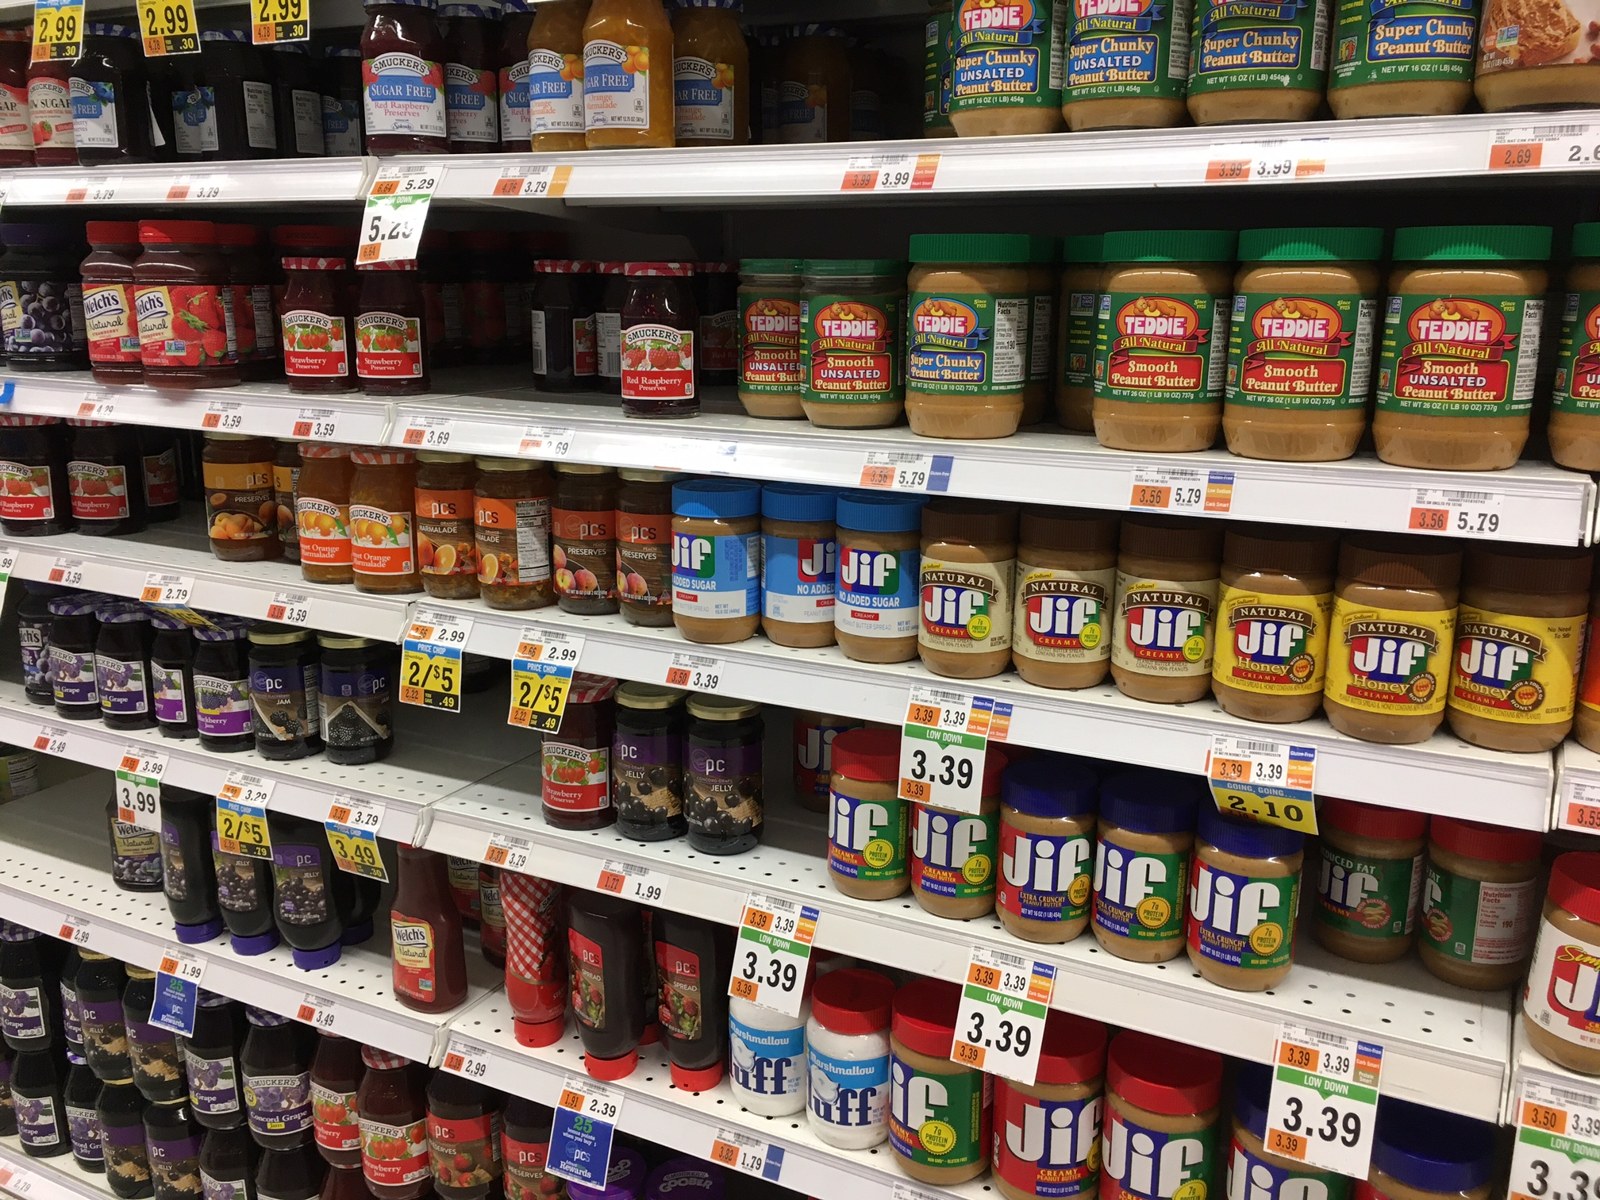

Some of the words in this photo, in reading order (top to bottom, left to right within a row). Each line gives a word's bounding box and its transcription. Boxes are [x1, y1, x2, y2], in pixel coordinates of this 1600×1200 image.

[146, 6, 189, 35] 2.99
[964, 6, 1020, 27] TEDDIE
[39, 16, 76, 42] 2.99
[289, 25, 303, 36] .30
[1375, 24, 1413, 40] Super
[1417, 19, 1474, 36] Chunky
[960, 34, 973, 46] All
[976, 32, 1018, 43] Natural
[62, 46, 76, 57] .30
[1376, 42, 1417, 57] Peanut
[1419, 42, 1471, 55] Butter
[373, 58, 428, 74] SMUCKER'S
[960, 68, 1024, 81] UNSALTED
[371, 84, 402, 97] SUGAR
[406, 85, 432, 98] FREE
[956, 83, 989, 95] Peanut
[991, 80, 1033, 92] Butter
[374, 101, 388, 110] Red
[390, 102, 430, 112] Raspberry
[384, 110, 420, 118] Preserves
[1505, 150, 1531, 164] 2.69
[1219, 164, 1242, 176] 3.99
[1257, 160, 1291, 176] 3.99
[404, 178, 434, 190] 5.29
[852, 174, 871, 186] 3.99
[882, 172, 909, 185] 3.99
[94, 190, 114, 199] 3.79
[524, 182, 547, 193] 3.79
[85, 292, 120, 312] Welch's
[88, 318, 124, 330] Natural
[822, 320, 878, 336] TEDDIE
[917, 316, 966, 332] TEDDIE
[1418, 321, 1490, 341] TEDDIE
[627, 329, 679, 343] SMUCKER'S
[916, 334, 926, 344] All
[929, 336, 967, 348] Natural
[820, 339, 833, 349] All
[836, 339, 875, 350] Natural
[1006, 341, 1016, 349] 190
[1413, 342, 1431, 354] All
[1436, 343, 1490, 358] Natural
[290, 356, 327, 365] Strawberry
[827, 358, 874, 367] Smooth
[911, 354, 932, 366] Super
[936, 354, 981, 370] Chunky
[1423, 361, 1478, 374] Smooth
[821, 369, 880, 378] UNSALTED
[911, 368, 939, 379] Peanut
[942, 369, 980, 380] Butter
[1410, 375, 1487, 386] UNSALTED
[627, 376, 639, 384] Red
[641, 376, 681, 386] Raspberry
[816, 380, 850, 390] Peanut
[852, 380, 887, 390] Butter
[1403, 386, 1448, 398] Peanut
[1451, 388, 1496, 399] Butter
[222, 416, 241, 427] 3.59
[314, 423, 334, 436] 3.59
[428, 431, 450, 444] 3.69
[899, 471, 925, 486] 5.79
[1174, 488, 1201, 504] 5.79
[1419, 512, 1444, 528] 3.56
[1457, 512, 1499, 531] 5.79
[842, 552, 896, 587] Jif
[925, 572, 985, 587] NATURAL
[166, 589, 187, 600] 2.79
[847, 594, 870, 606] ADDED
[872, 597, 900, 607] SUGAR
[924, 588, 984, 625] Jif
[288, 609, 306, 621] 3.59
[1241, 609, 1304, 621] NATURAL
[438, 630, 465, 642] 2.99
[931, 626, 964, 635] CREAMY
[1464, 625, 1530, 645] NATURAL
[1238, 623, 1303, 657] Jif
[418, 644, 433, 652] PRICE
[435, 646, 446, 654] CHOP
[548, 648, 576, 661] 2.99
[1238, 657, 1290, 674] Honey
[1461, 640, 1528, 681] Jif
[693, 674, 718, 689] 3.39
[1242, 671, 1276, 681] CREAMY
[1459, 676, 1511, 700] Honey
[404, 689, 419, 699] 2.22
[439, 697, 454, 707] .49
[1463, 693, 1495, 704] CREAMY
[514, 710, 527, 722] 2.22
[542, 718, 556, 728] .49
[914, 708, 933, 722] 3.39
[943, 710, 966, 725] 3.39
[926, 730, 941, 740] LOW
[942, 734, 962, 744] DOWN
[50, 740, 66, 752] 2.49
[142, 761, 162, 774] 3.99
[911, 750, 973, 789] 3.39
[1220, 762, 1242, 778] 3.39
[1256, 763, 1282, 780] 3.39
[711, 784, 733, 792] JELLY
[122, 788, 156, 814] 3.99
[1228, 796, 1303, 822] 2.10
[355, 812, 378, 824] 3.79
[913, 809, 987, 868] Jif
[253, 847, 267, 856] .79
[336, 840, 375, 865] 3.49
[509, 854, 526, 867] 3.79
[1003, 835, 1090, 891] Jif
[370, 869, 382, 877] .30
[636, 883, 661, 900] 1.99
[1191, 868, 1280, 935] Jif
[74, 930, 89, 942] 2.99
[394, 928, 424, 942] Welch's
[1200, 930, 1218, 941] EXTRA
[1221, 938, 1246, 948] CRUNCHY
[1265, 928, 1272, 937] 7g
[399, 948, 427, 958] Natural
[182, 964, 201, 978] 1.99
[743, 952, 797, 991] 3.39
[673, 981, 698, 991] SPREAD
[736, 982, 752, 995] 3.39
[316, 1011, 334, 1026] 3.49
[968, 1012, 1031, 1057] 3.39
[960, 1046, 978, 1061] 3.39
[1288, 1048, 1310, 1066] 3.39
[1324, 1053, 1349, 1072] 3.39
[466, 1062, 486, 1076] 2.99
[811, 1052, 874, 1074] Marshmallow
[1304, 1075, 1322, 1086] LOW
[1324, 1081, 1348, 1094] DOWN
[590, 1100, 616, 1117] 2.39
[574, 1116, 592, 1132] 25
[1283, 1097, 1361, 1146] 3.39
[1532, 1108, 1557, 1127] 3.50
[1276, 1135, 1298, 1150] 3.39
[741, 1153, 762, 1170] 1.79
[508, 1165, 543, 1178] PRESERVES
[560, 1162, 591, 1178] Rewards
[660, 1177, 711, 1191] GOOBER
